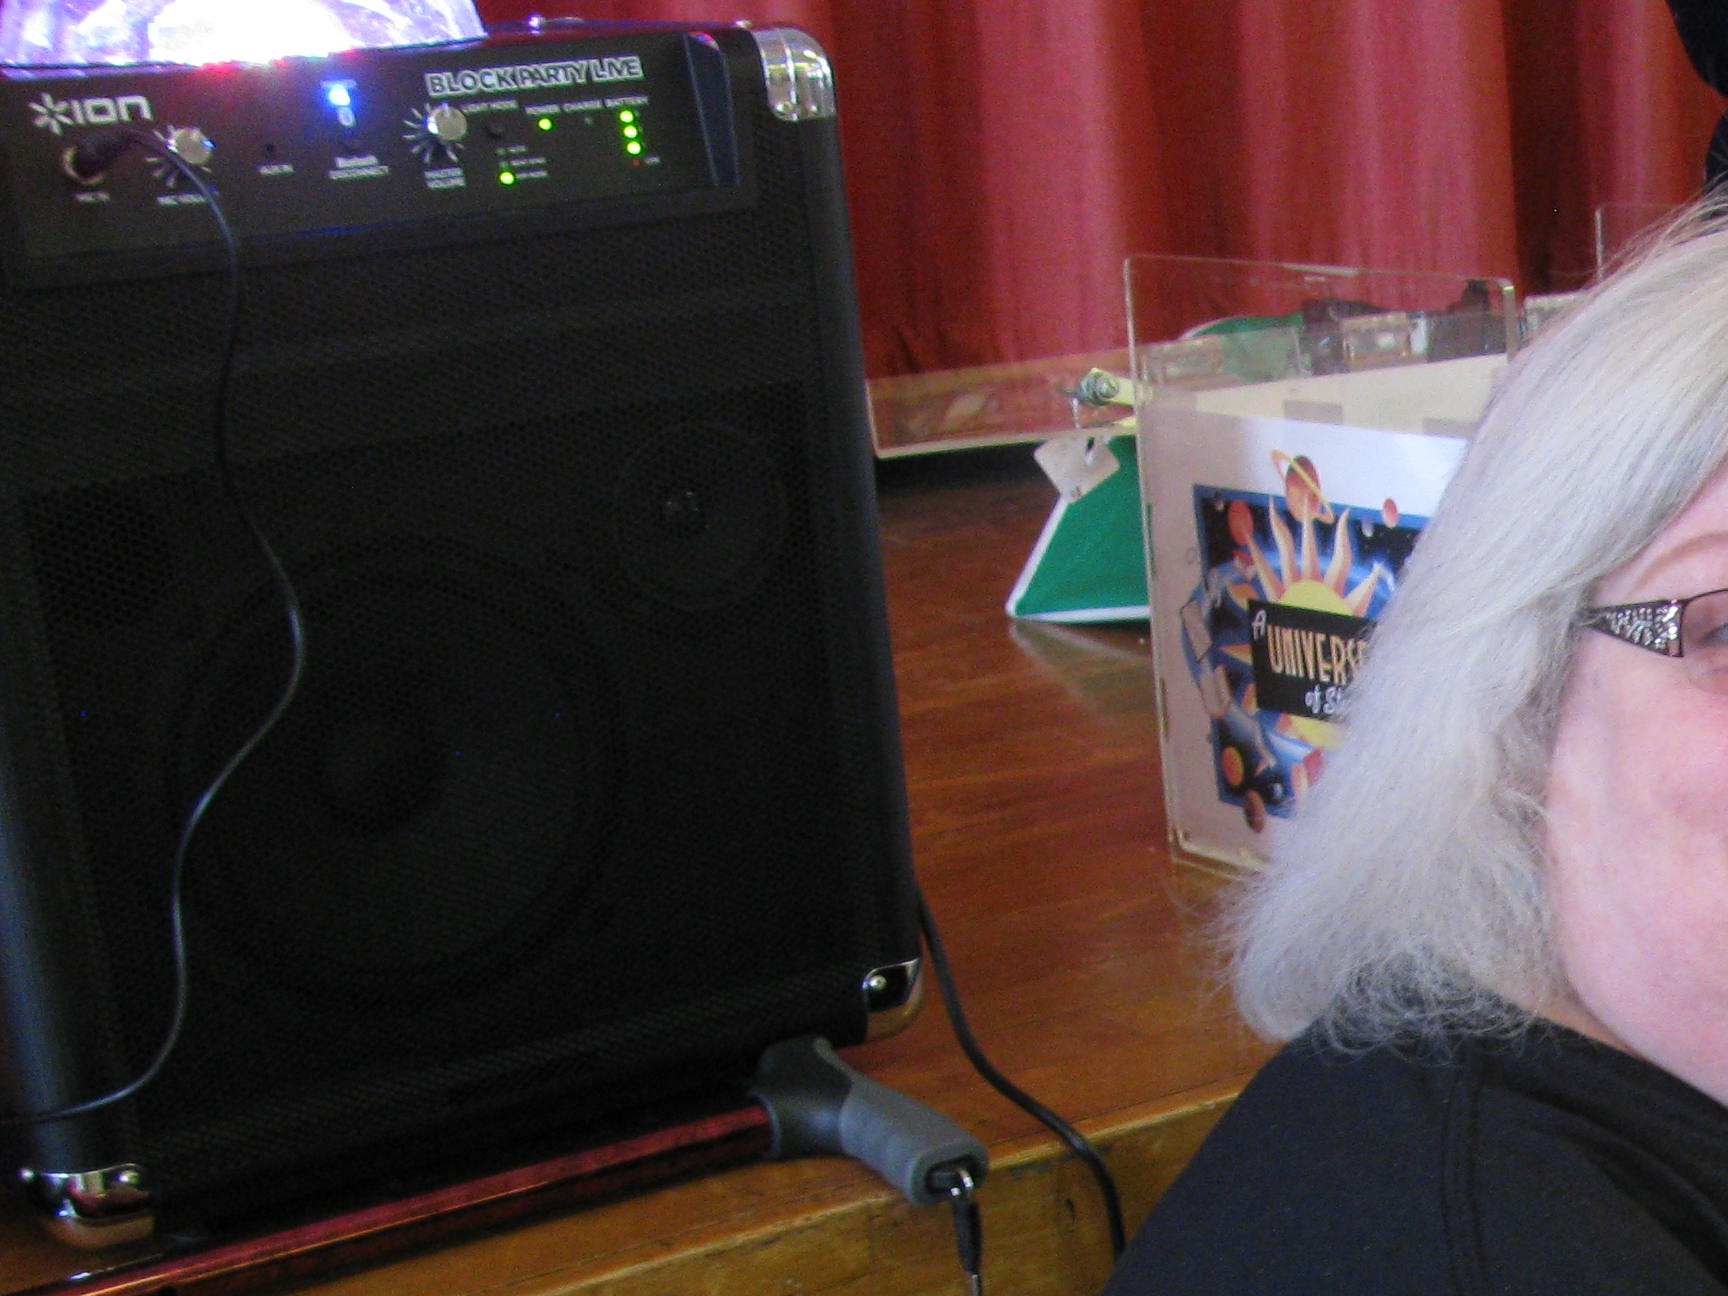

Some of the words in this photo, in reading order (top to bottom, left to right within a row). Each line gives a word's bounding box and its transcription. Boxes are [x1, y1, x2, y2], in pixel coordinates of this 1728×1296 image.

[589, 56, 644, 83] LIVE
[1252, 609, 1267, 641] A
[1304, 684, 1321, 714] of
